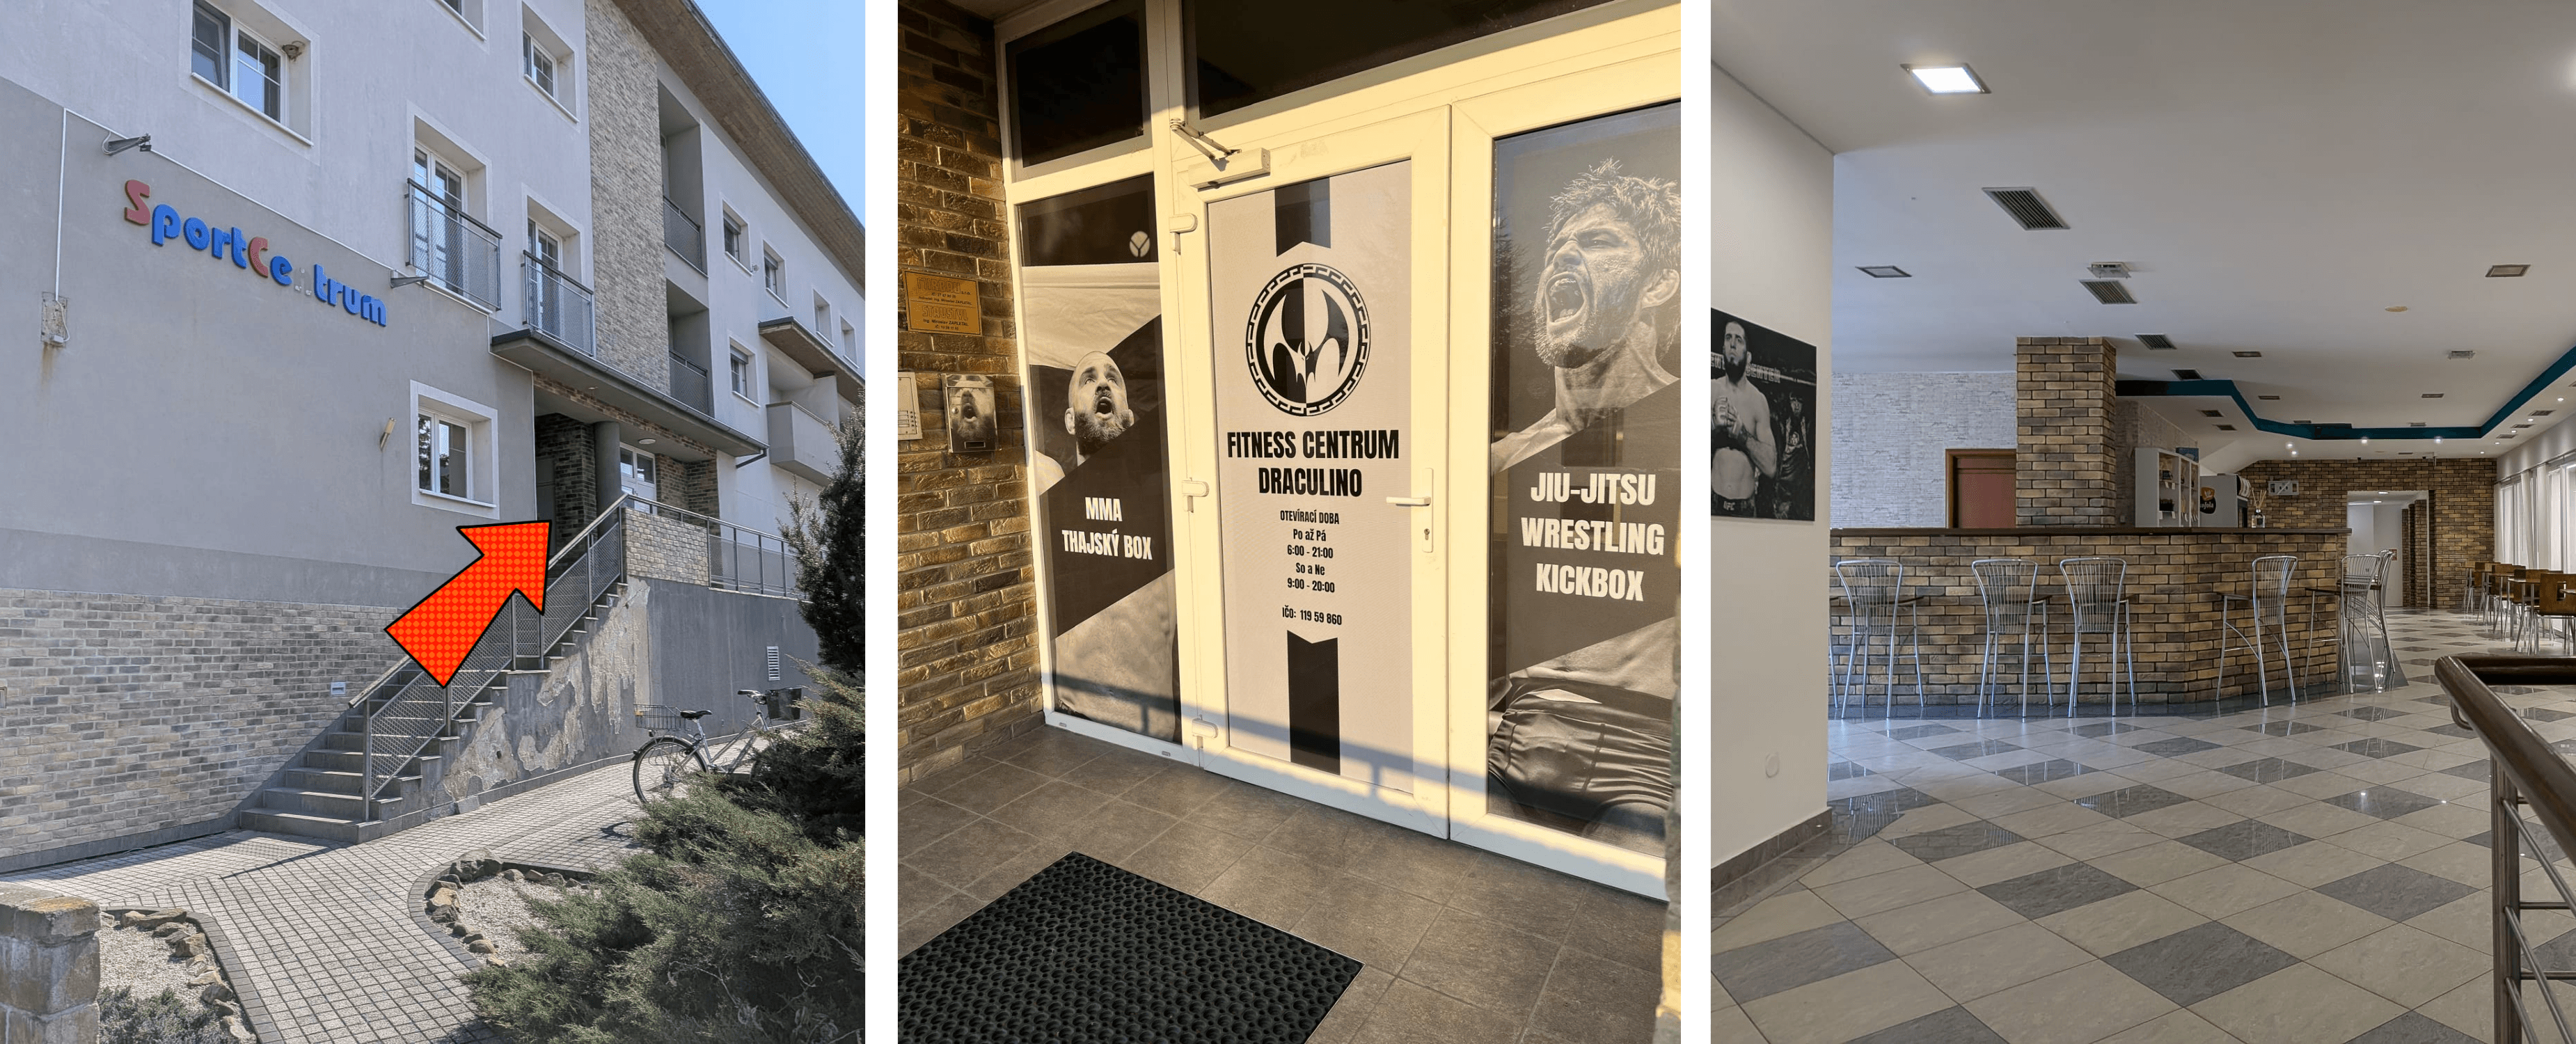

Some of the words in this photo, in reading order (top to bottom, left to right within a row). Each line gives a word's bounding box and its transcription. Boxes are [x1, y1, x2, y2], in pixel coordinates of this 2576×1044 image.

[124, 179, 387, 327] SportCetrum
[1227, 431, 1296, 459] FITNESS
[1303, 429, 1399, 459] CENTRUM
[1258, 468, 1362, 497] DRACULINO
[1531, 473, 1656, 505] JIU-JITSU
[1085, 497, 1123, 521] MMA
[1280, 509, 1317, 523] OTEVÍRACÍ
[1319, 512, 1340, 524] DOBA
[1061, 528, 1119, 557] THAJSKÝ
[1123, 535, 1153, 560] BOX
[1293, 529, 1303, 540] Po
[1305, 528, 1314, 541] až
[1316, 530, 1326, 541] Pá
[1521, 517, 1664, 555] WRESTLING
[1287, 544, 1304, 556] 6:00
[1312, 546, 1334, 558] 21:00
[1296, 562, 1305, 574] So
[1308, 565, 1313, 574] a
[1315, 564, 1325, 576] Ne
[1536, 562, 1644, 601] KICKBOX
[1287, 578, 1304, 590] 9:00
[1312, 580, 1335, 593] 20:00
[1282, 605, 1296, 619] IČO:
[1300, 610, 1312, 621] 119
[1314, 611, 1325, 623] 59
[1327, 613, 1342, 625] 860
